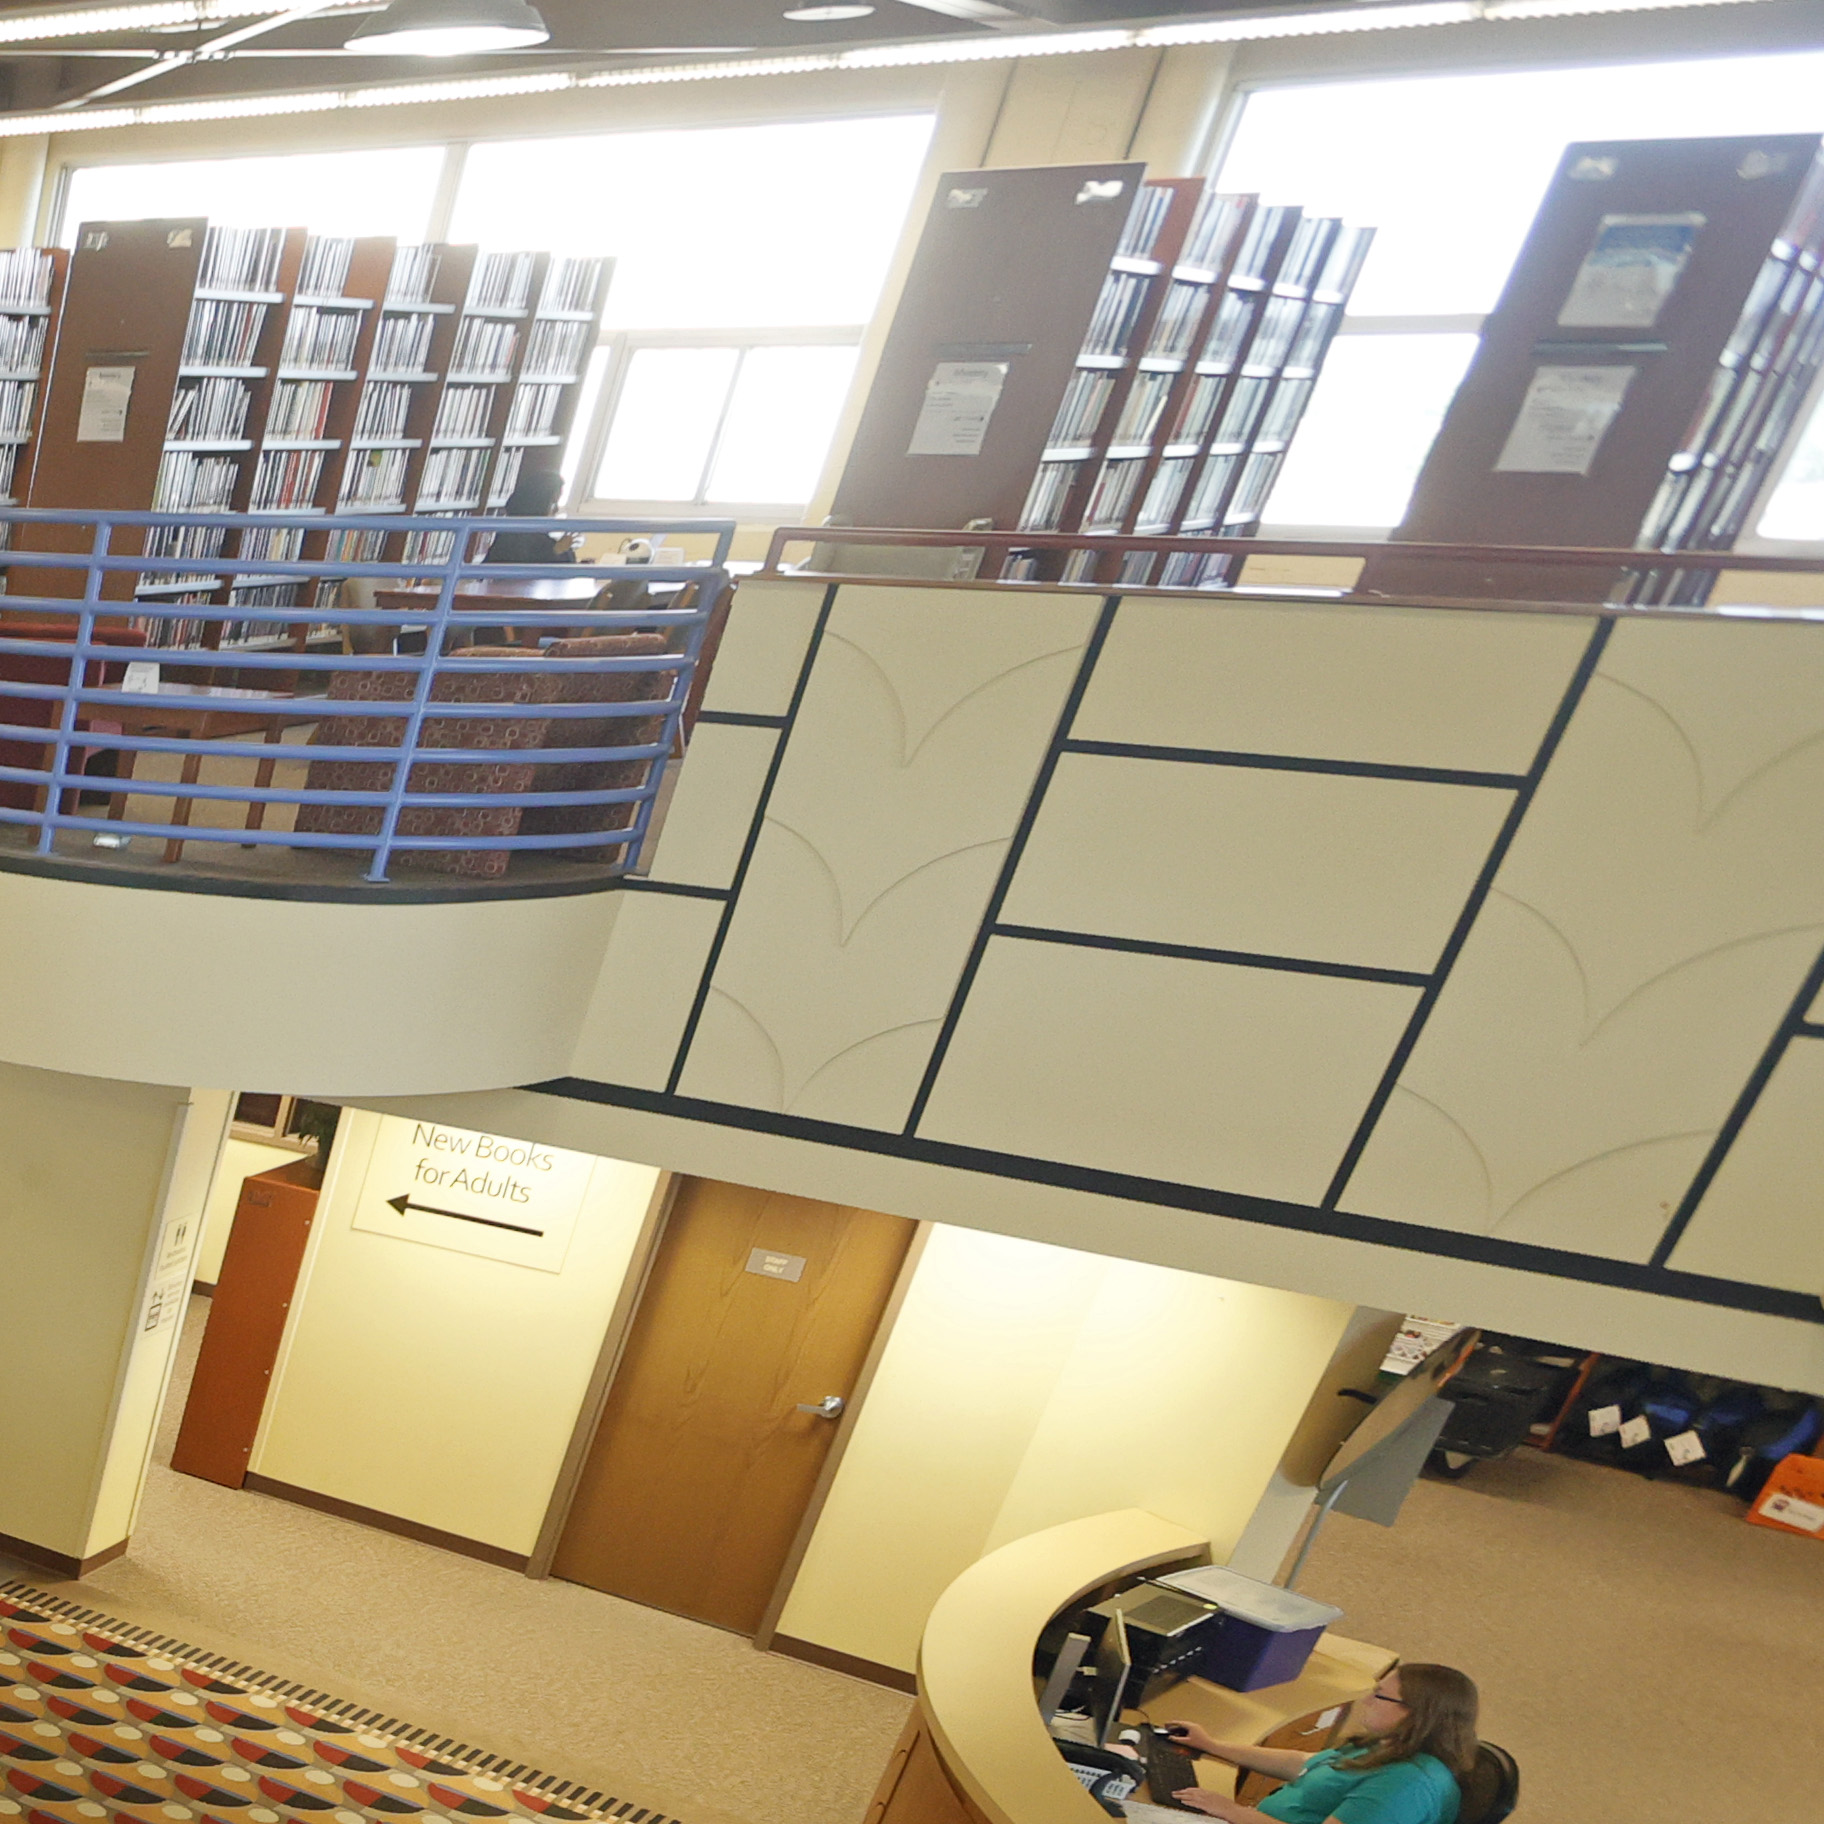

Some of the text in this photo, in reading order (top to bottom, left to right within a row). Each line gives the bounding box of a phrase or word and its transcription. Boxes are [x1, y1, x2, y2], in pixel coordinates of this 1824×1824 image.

[412, 1123, 555, 1172] New Books
[415, 1157, 532, 1204] for Adults
